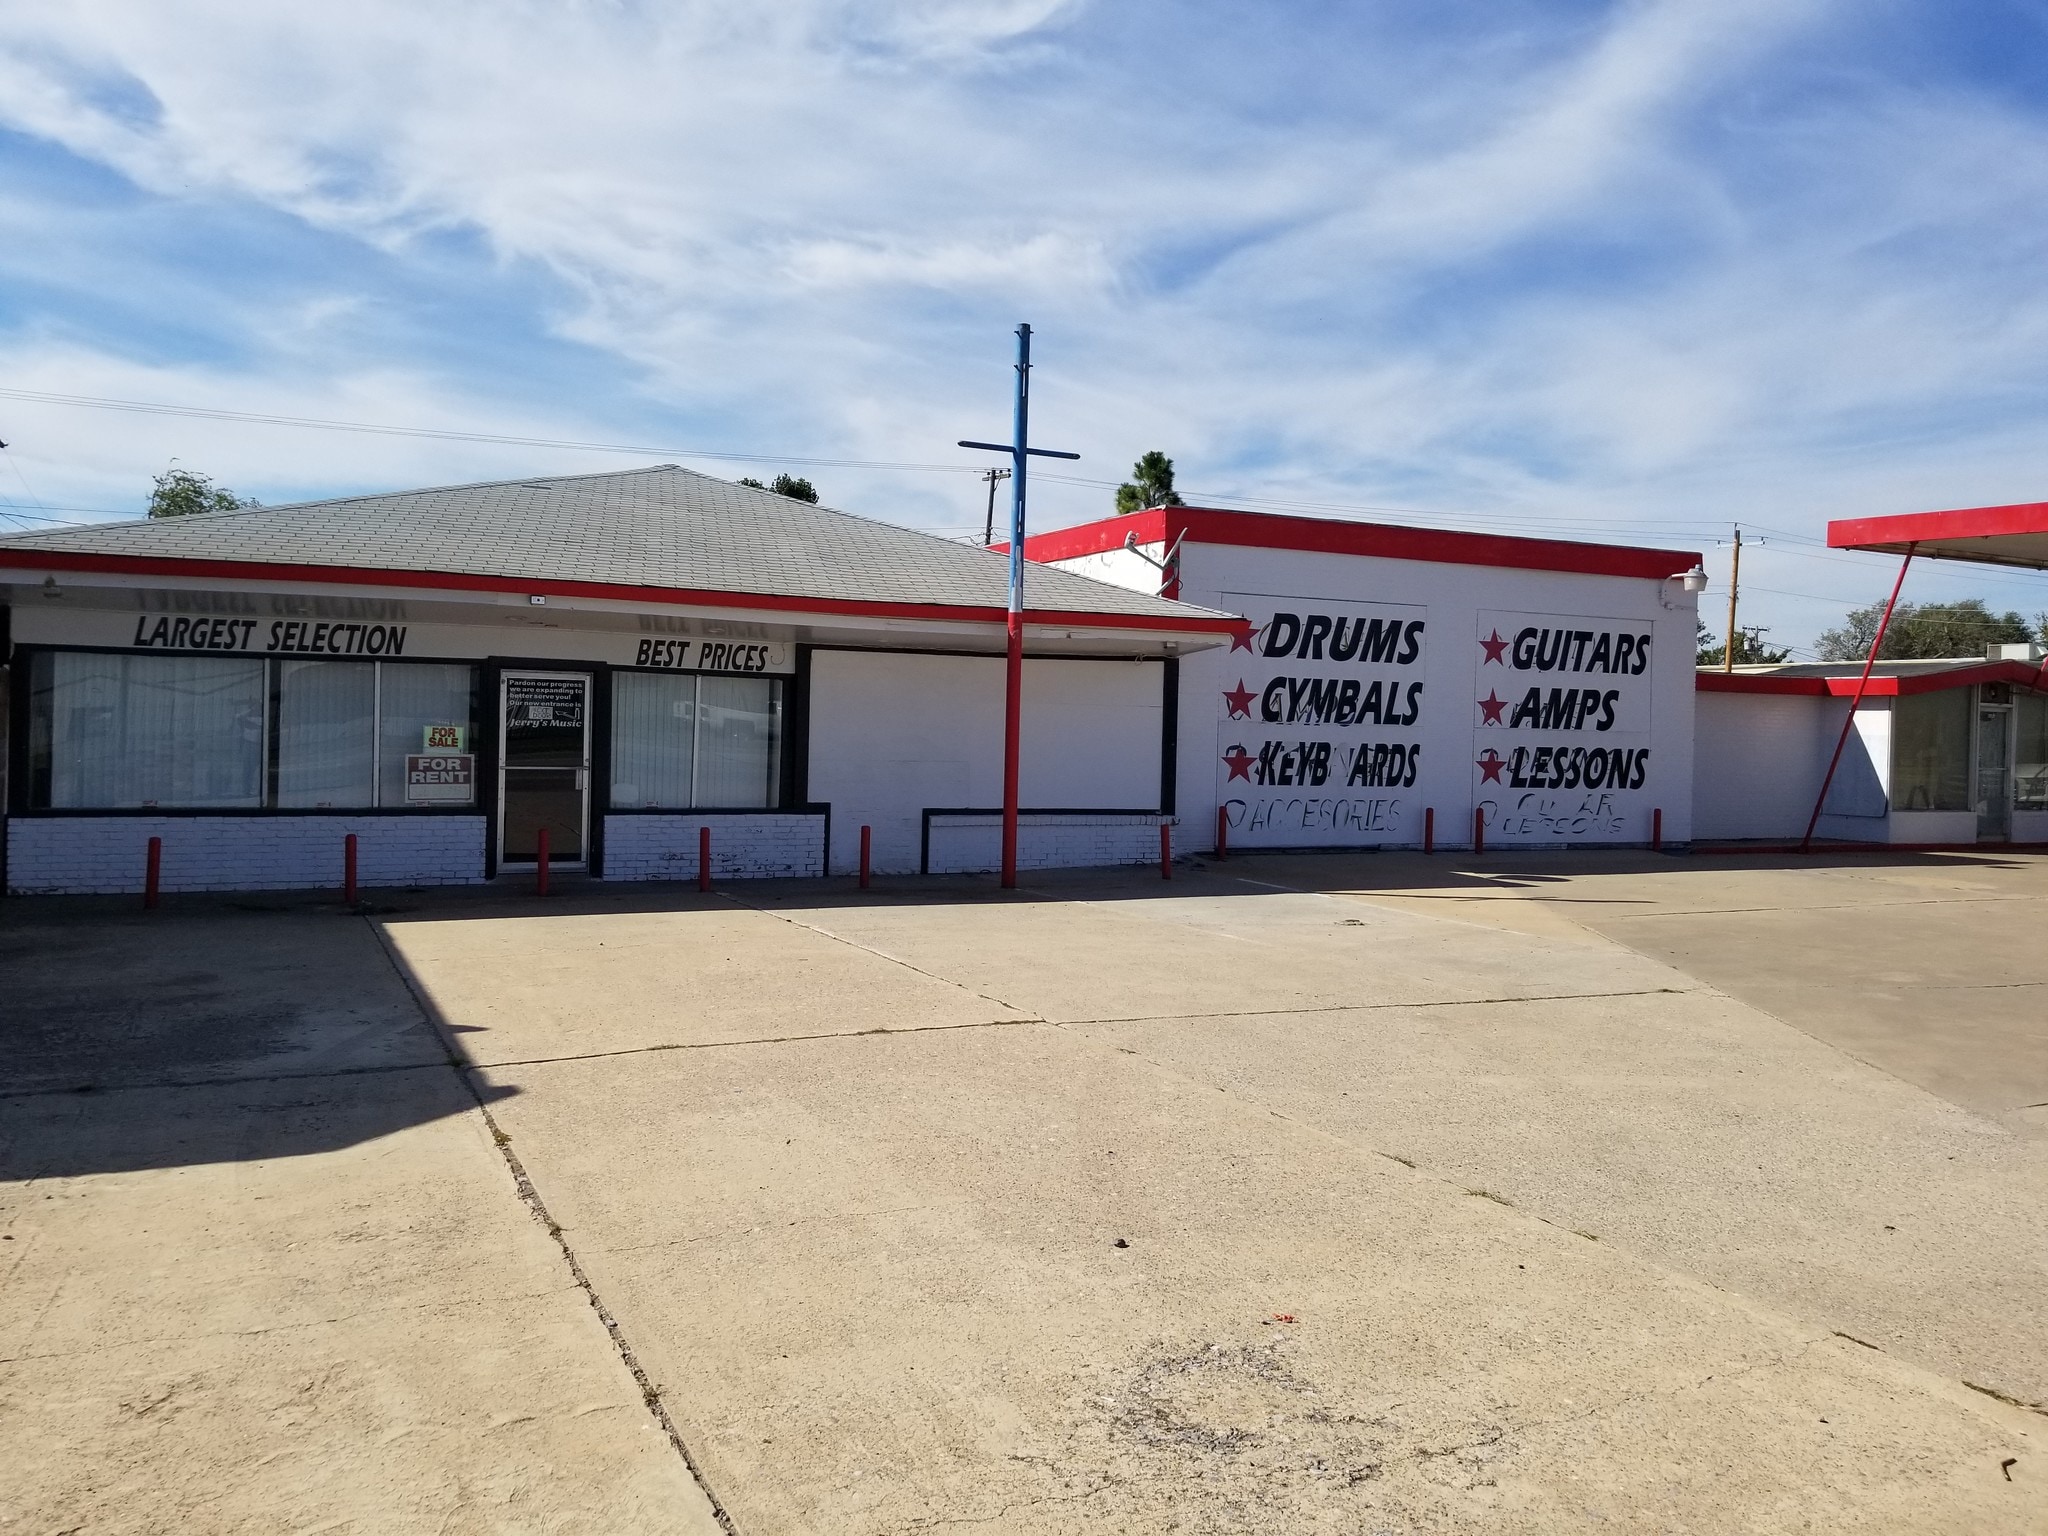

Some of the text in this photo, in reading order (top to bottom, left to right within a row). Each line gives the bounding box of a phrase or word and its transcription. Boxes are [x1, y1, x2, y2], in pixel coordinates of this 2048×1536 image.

[133, 616, 407, 655] LARGEST SELECTION
[1262, 612, 1426, 665] DRUMS
[1511, 627, 1651, 676] GUITARS
[635, 639, 769, 672] BEST PRICES
[1261, 676, 1424, 726] CYMBALS
[1510, 687, 1620, 731] AMPS
[428, 737, 458, 747] SALE
[432, 728, 456, 737] FOR
[509, 719, 582, 728] Jerry's Music
[411, 771, 468, 783] RENT
[418, 759, 461, 770] FOR
[1258, 741, 1421, 788] KEYBARDS
[1509, 746, 1649, 789] LESSONS
